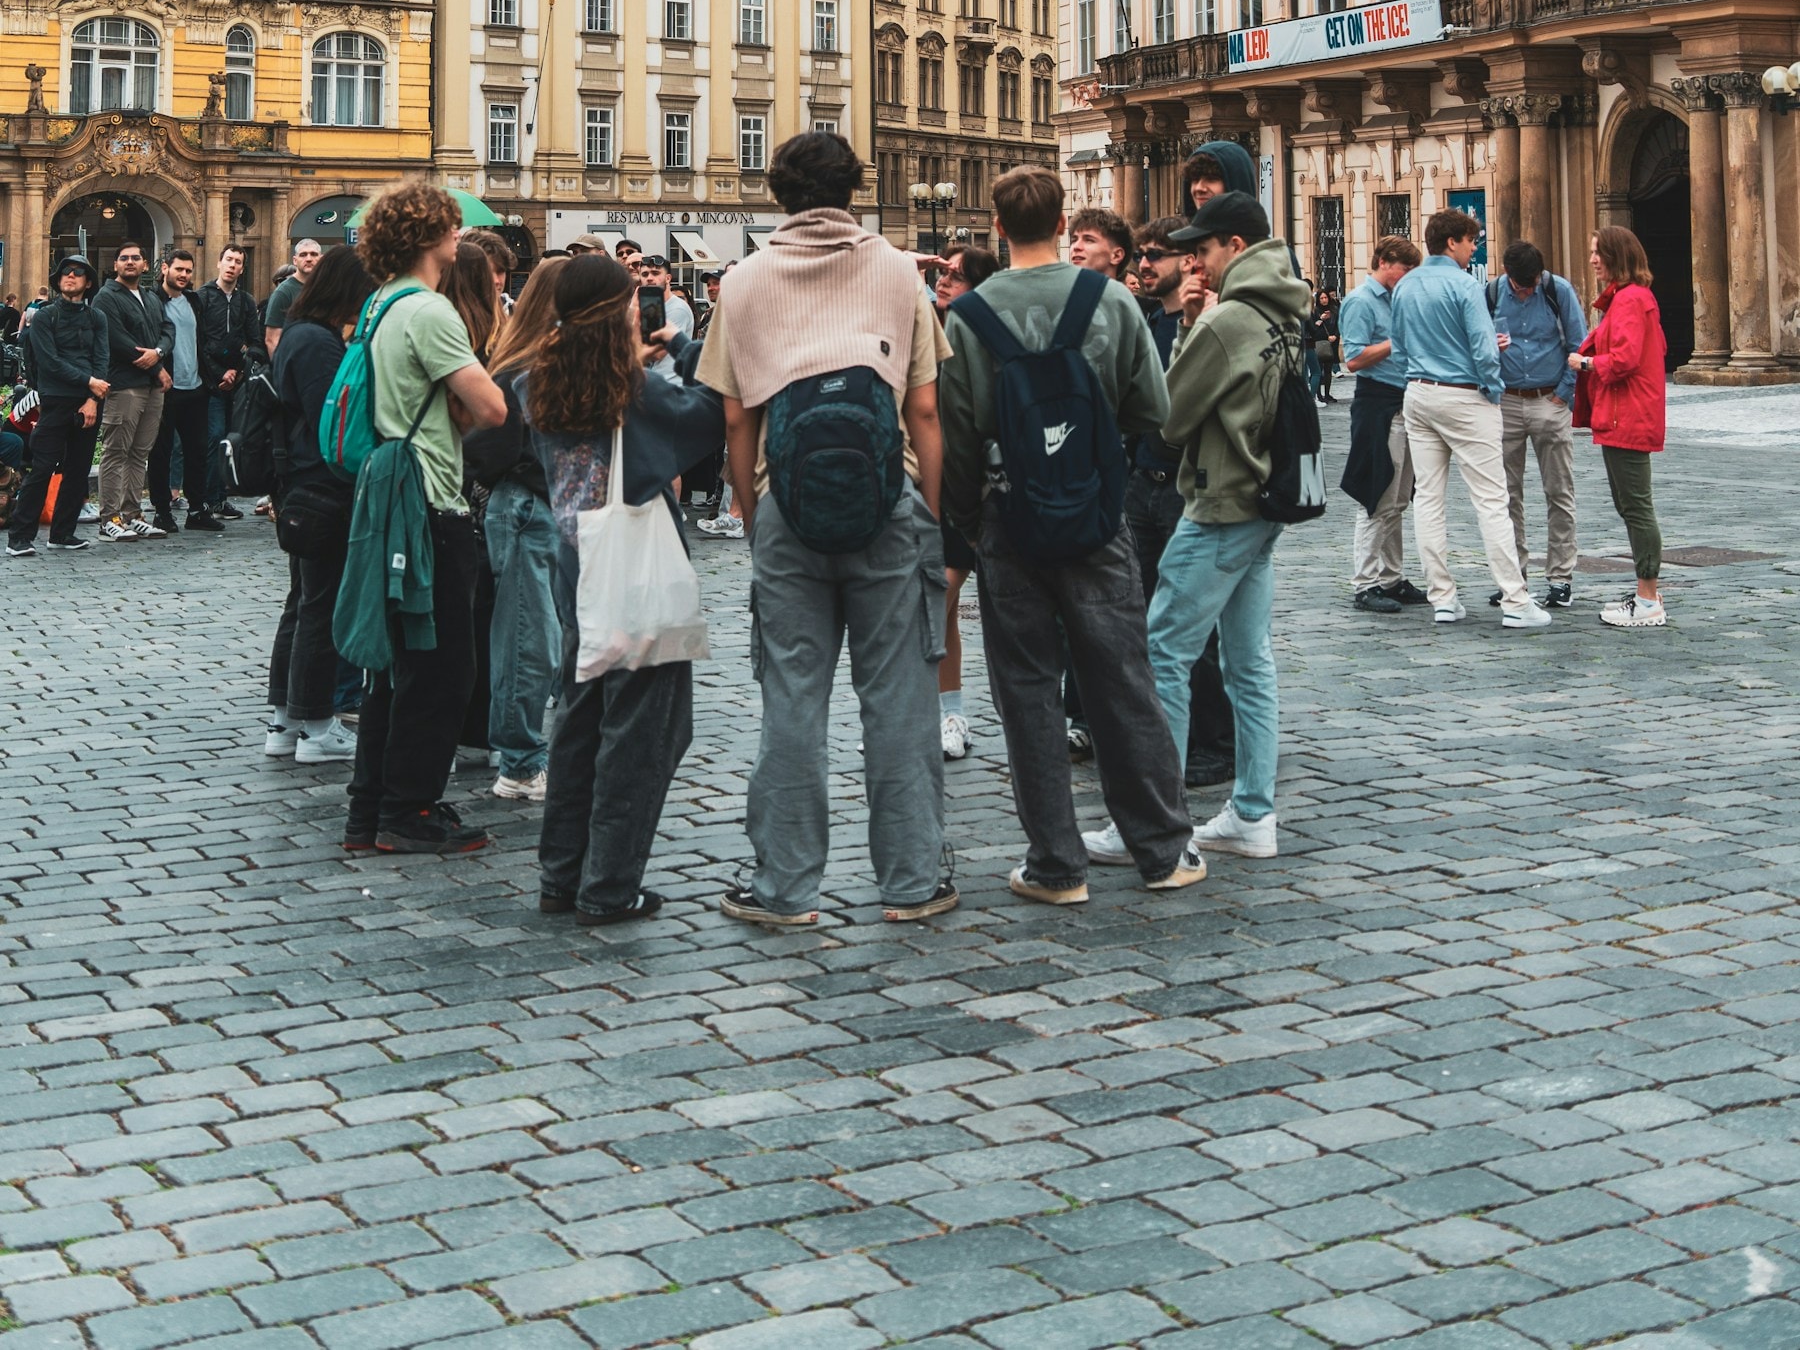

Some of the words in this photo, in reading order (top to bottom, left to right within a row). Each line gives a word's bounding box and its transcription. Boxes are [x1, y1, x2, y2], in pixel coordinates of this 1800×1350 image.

[1325, 16, 1345, 49] GET
[1349, 12, 1365, 46] ON
[1364, 8, 1386, 43] THE
[1386, 3, 1411, 39] ICE!
[1228, 33, 1245, 64] NA
[1245, 28, 1269, 61] LED!
[607, 211, 676, 224] RESTAURACE
[696, 212, 755, 225] MINCOVNA
[1043, 421, 1068, 445] NIKE
